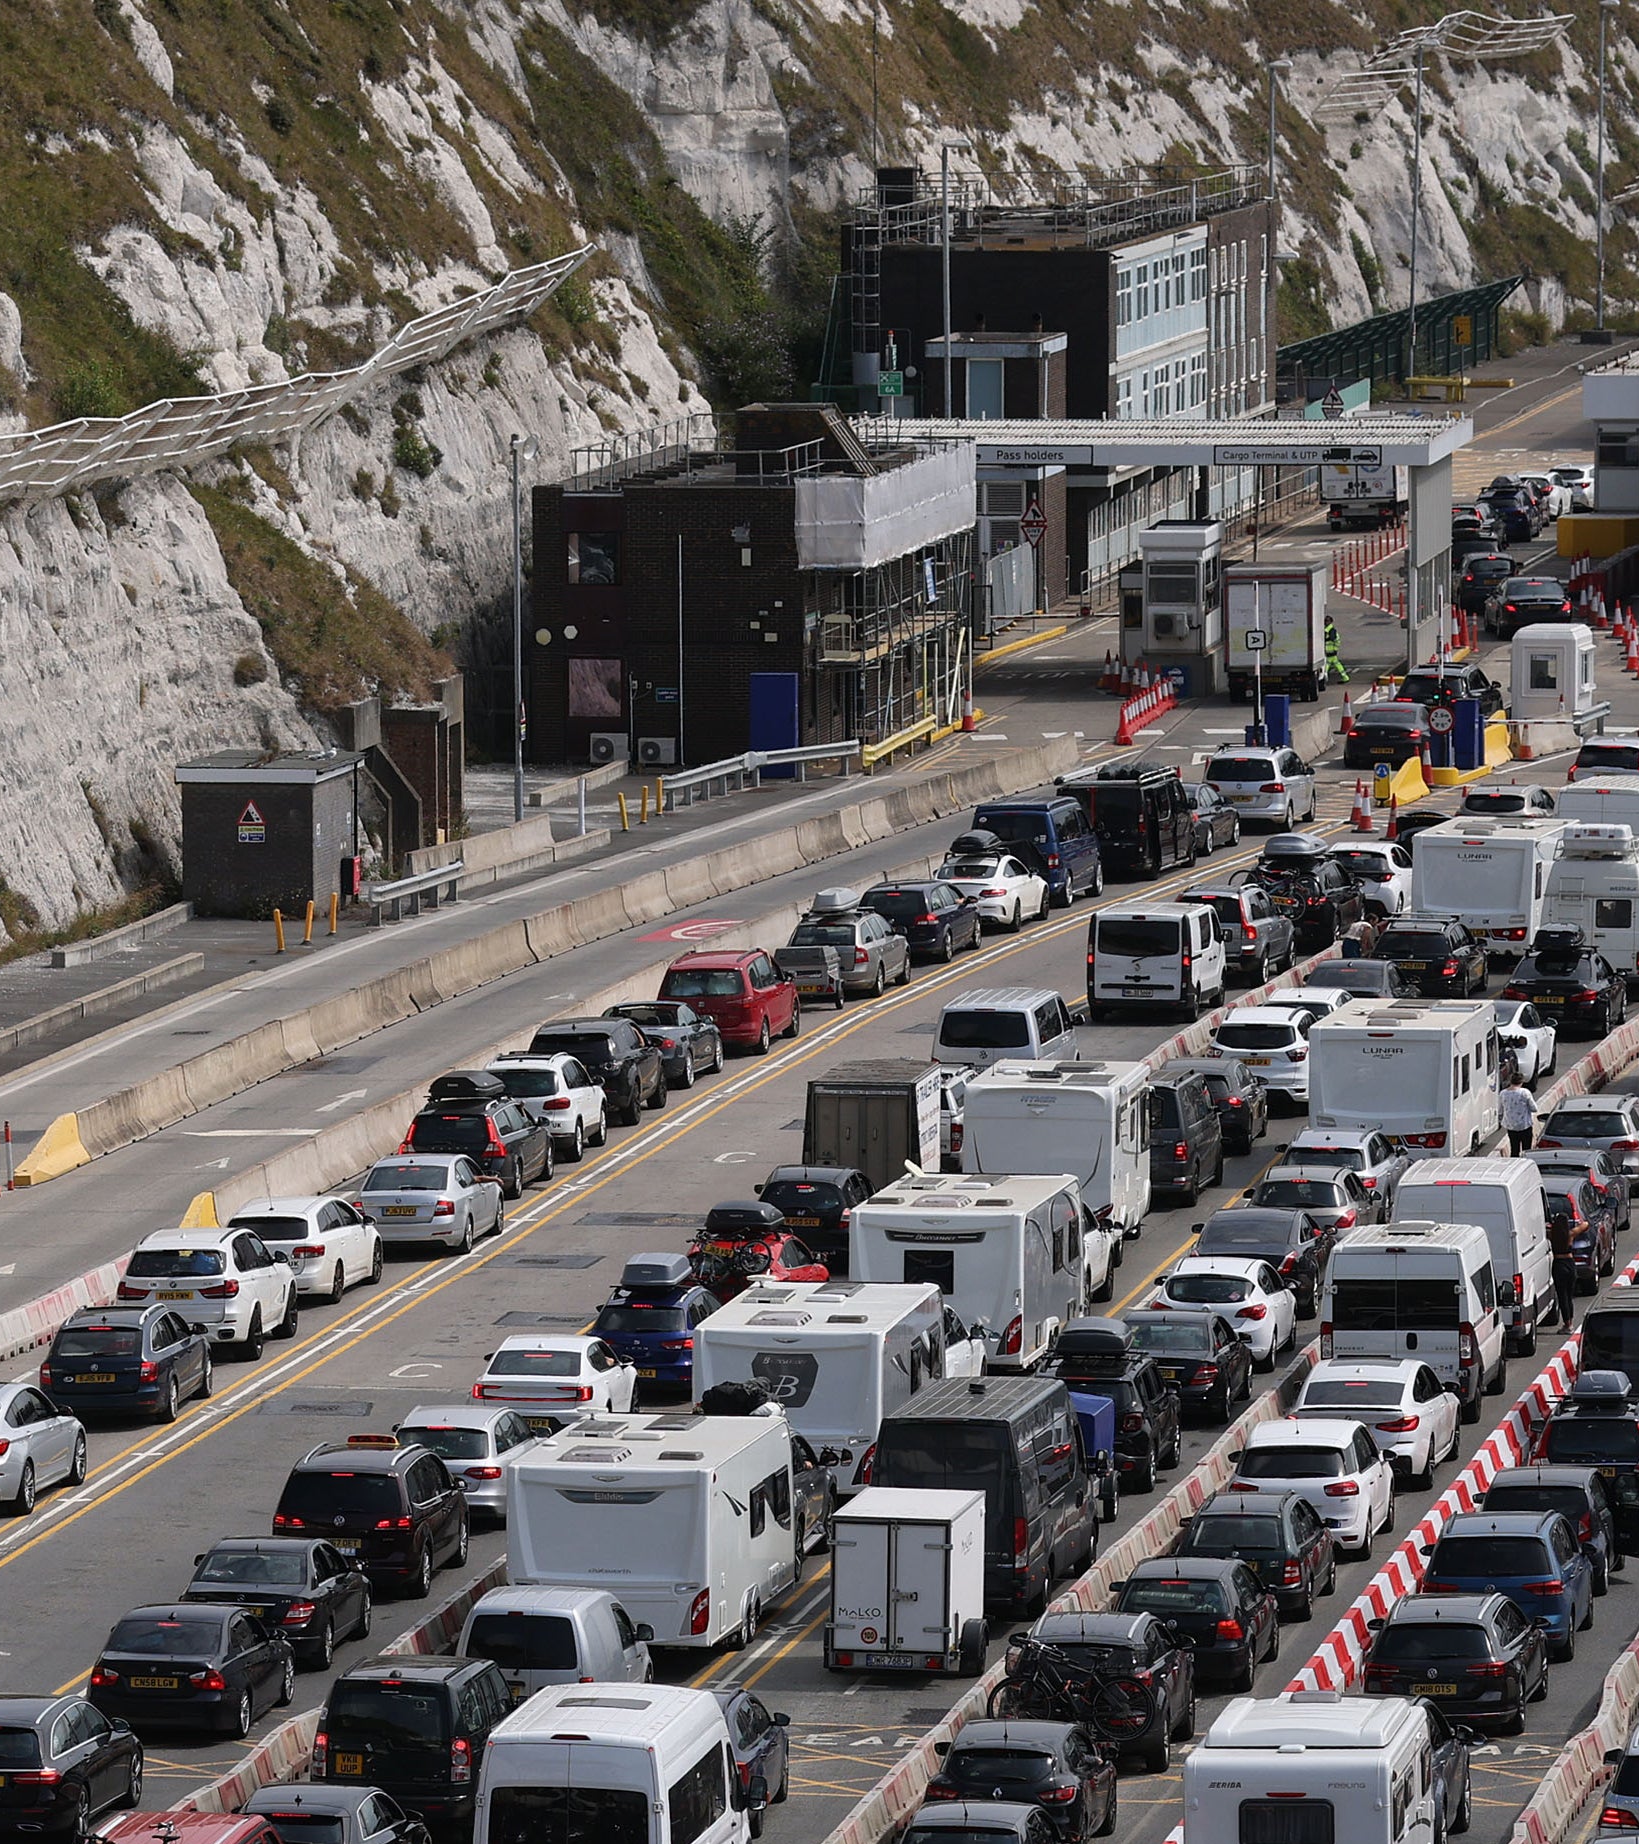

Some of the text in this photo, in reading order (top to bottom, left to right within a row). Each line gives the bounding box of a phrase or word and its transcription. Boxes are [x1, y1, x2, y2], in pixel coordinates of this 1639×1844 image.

[996, 448, 1064, 460] Pass holders
[1223, 452, 1246, 462] Cargo
[1250, 451, 1288, 461] Terminal
[1300, 452, 1318, 461] UTP
